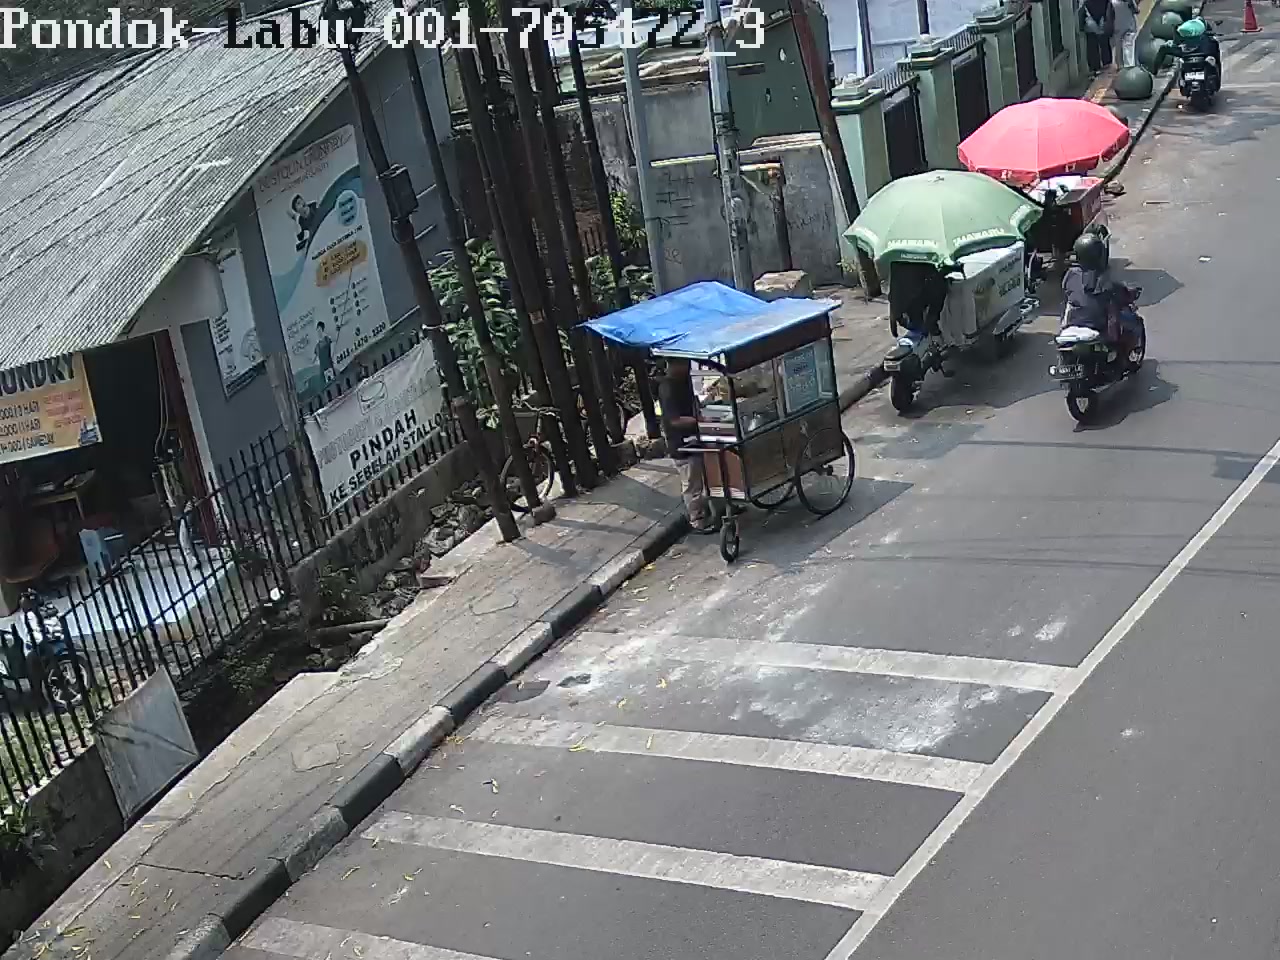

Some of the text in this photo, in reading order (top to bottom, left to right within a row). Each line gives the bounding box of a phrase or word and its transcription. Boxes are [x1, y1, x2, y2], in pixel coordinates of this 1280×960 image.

[350, 408, 417, 470] PINDAH
[330, 482, 347, 503] KE
[349, 443, 400, 491] SEBELAH
